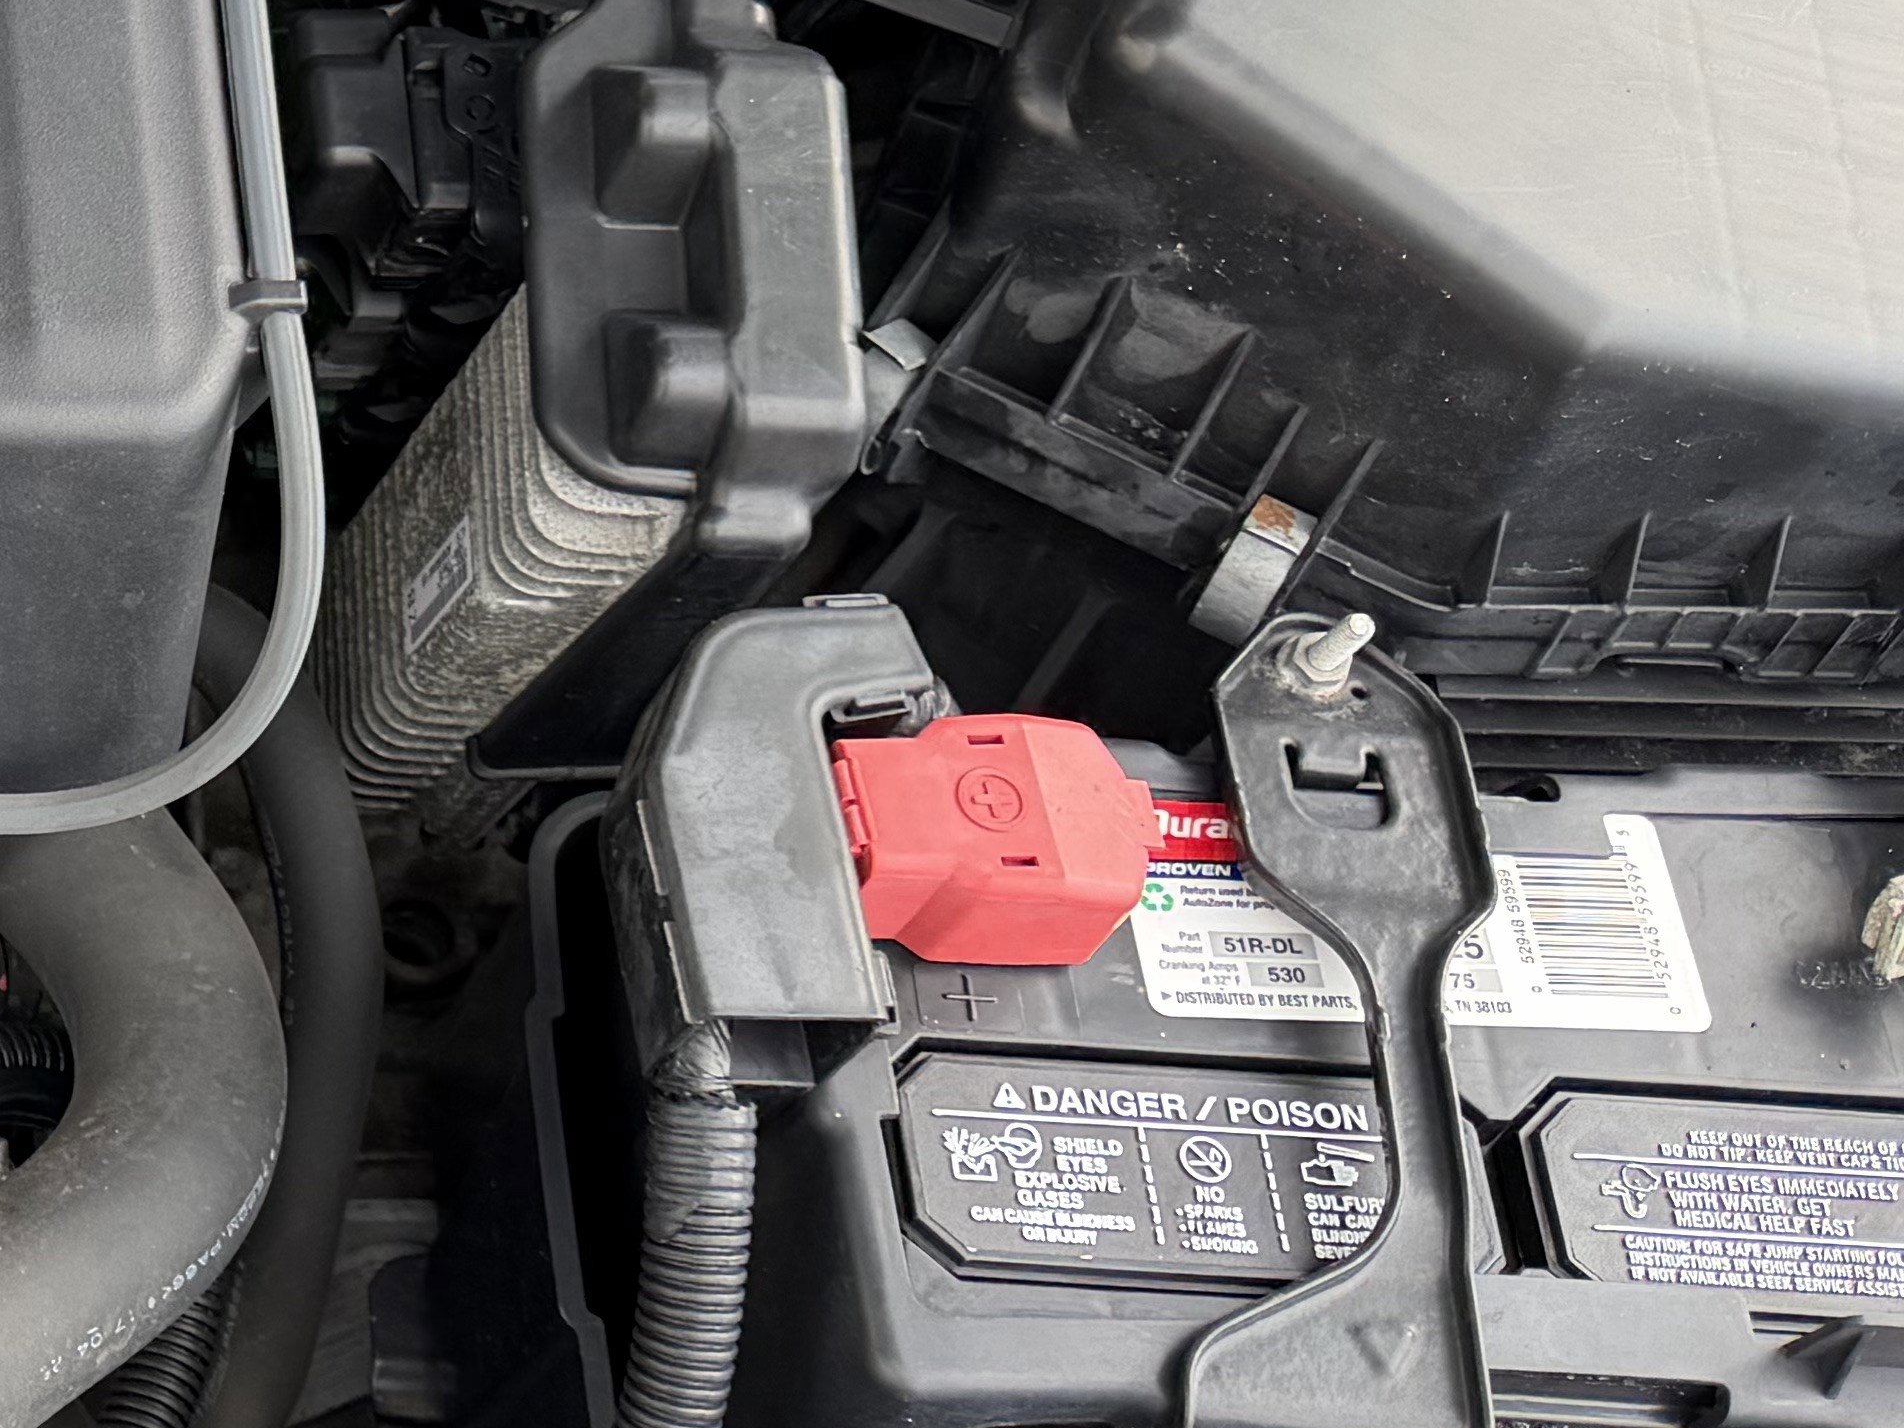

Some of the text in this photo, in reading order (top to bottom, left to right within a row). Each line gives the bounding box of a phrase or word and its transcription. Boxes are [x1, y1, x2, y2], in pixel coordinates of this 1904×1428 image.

[1145, 861, 1232, 877] PROVEN
[1182, 896, 1234, 908] AutoZone
[1223, 936, 1304, 955] 51R-DL
[1158, 959, 1239, 973] Cranking Amps
[1267, 966, 1306, 984] 530
[1175, 990, 1358, 1011] DISTRIBUTED BY BEST PARTS,
[1030, 1084, 1370, 1133] DANGER / POISON
[1053, 1136, 1124, 1156] SHIELD
[1690, 1130, 1898, 1156] KEEP OUT OF THE REACH OF
[1056, 1154, 1109, 1174] EYES
[1660, 1143, 1683, 1158] DO
[1686, 1144, 1717, 1161] NOT
[1754, 1148, 1794, 1166] KEEP
[1796, 1151, 1837, 1168] VENT
[1014, 1171, 1123, 1194] EXPLOSIVE
[1663, 1170, 1899, 1202] FLUSH EYES IMMEDIATELY
[1016, 1189, 1085, 1210] GASES
[1194, 1184, 1226, 1204] NO
[1302, 1192, 1386, 1215] SULFUR
[1668, 1190, 1719, 1211] WITH
[1796, 1197, 1832, 1218] GET
[970, 1204, 1004, 1223] CAN
[1004, 1208, 1055, 1227] CAUSE
[1307, 1212, 1341, 1227] CAN
[1674, 1209, 1856, 1238] MEDICAL HELP FAST
[1021, 1225, 1098, 1246] OR INJURY
[1191, 1235, 1259, 1255] SMOKING
[1624, 1233, 1692, 1254] CAUTION:
[1693, 1239, 1723, 1256] FOR
[1724, 1241, 1762, 1259] SAFE
[1763, 1243, 1804, 1262] JUMP
[1805, 1246, 1877, 1266] STARTING
[1627, 1250, 1732, 1273] INSTRUCTIONS
[1733, 1257, 1750, 1273] IN
[1751, 1258, 1811, 1278] VEHICLE
[1813, 1262, 1875, 1282] OWNERS
[1631, 1266, 1644, 1281] IF
[1647, 1267, 1676, 1284] NOT
[1680, 1269, 1755, 1289] AVAILABLE
[1756, 1273, 1794, 1292] SEEK
[1795, 1276, 1856, 1296] SERVICE
